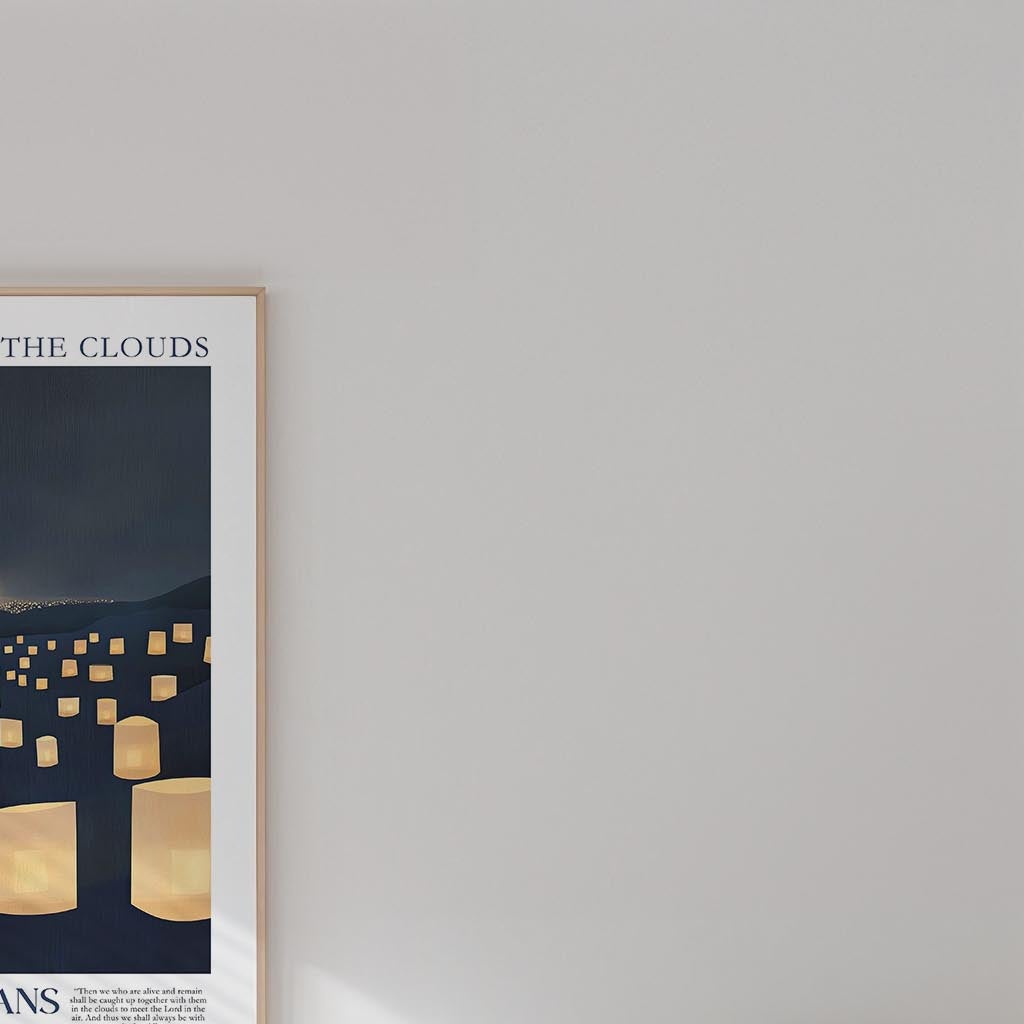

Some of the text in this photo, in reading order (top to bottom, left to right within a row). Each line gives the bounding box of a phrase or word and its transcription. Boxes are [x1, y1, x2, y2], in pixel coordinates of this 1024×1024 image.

[0, 336, 67, 359] THE
[79, 336, 209, 359] CLOUDS
[111, 987, 128, 995] who
[142, 987, 160, 995] alive
[162, 987, 176, 995] and
[177, 987, 203, 995] remain
[70, 996, 207, 1006] shall be caught up together with them
[71, 1005, 79, 1013] in
[80, 1005, 93, 1013] the
[94, 1005, 119, 1013] clouds
[150, 1005, 163, 1013] the
[164, 1005, 183, 1013] Lord
[184, 1005, 192, 1013] in
[193, 1005, 206, 1013] the
[71, 1014, 84, 1022] air.
[85, 1014, 101, 1022] And
[103, 1014, 120, 1022] thus
[133, 1014, 151, 1022] shall
[152, 1014, 177, 1024] always
[178, 1014, 187, 1022] be
[188, 1014, 206, 1022] with
